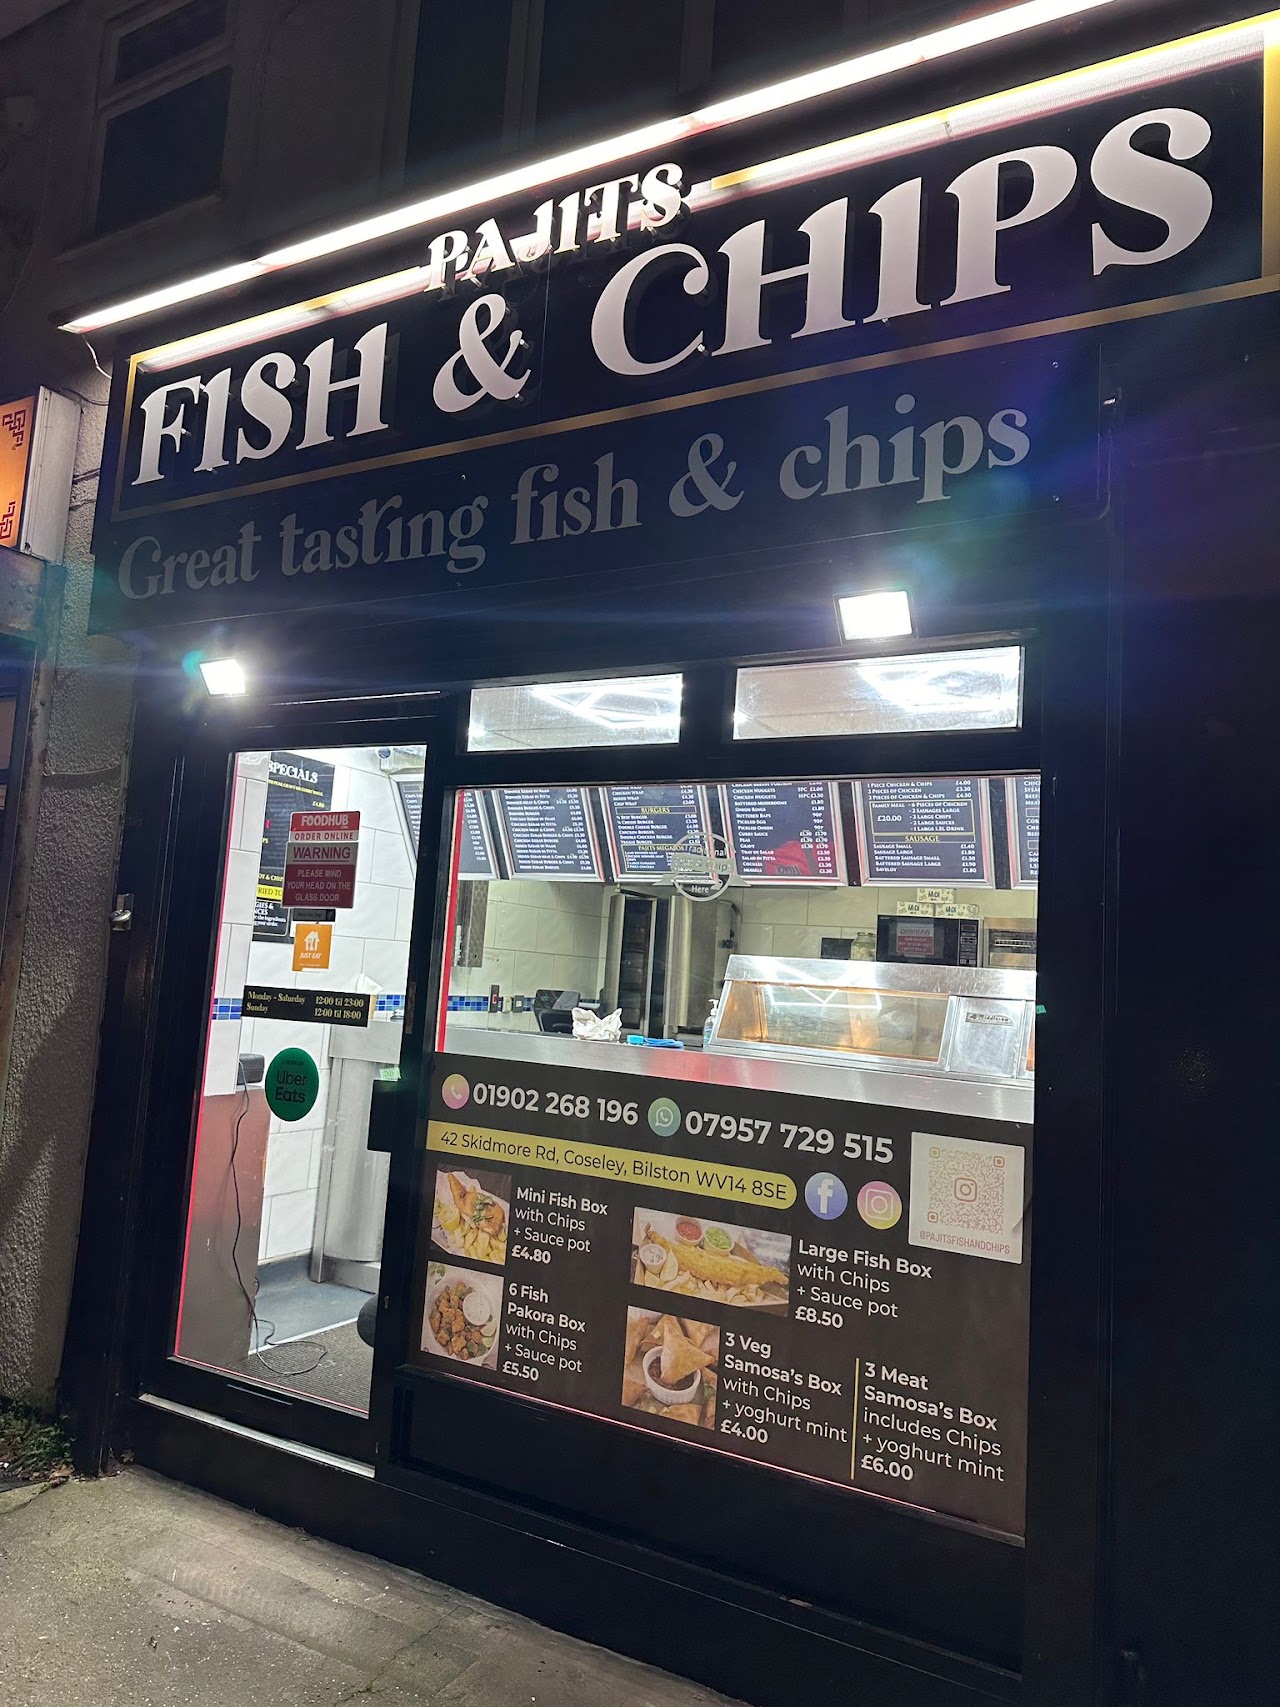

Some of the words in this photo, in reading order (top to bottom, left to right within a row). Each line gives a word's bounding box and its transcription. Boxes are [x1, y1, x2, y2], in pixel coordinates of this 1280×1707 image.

[424, 162, 686, 293] PAJITS
[131, 322, 389, 486] FISH
[433, 294, 531, 413] &
[591, 108, 1213, 376] CHIPS
[118, 521, 261, 600] Great
[279, 494, 488, 574] tasting
[510, 452, 642, 545] fish
[669, 432, 744, 518] &
[779, 393, 1030, 505] chips
[301, 814, 348, 827] FOODHUB
[294, 832, 321, 841] ORDER
[324, 831, 354, 841] ONLINE
[293, 846, 351, 860] WARNING
[287, 881, 305, 890] YOUR
[306, 881, 325, 890] HEAD
[326, 881, 337, 890] ON
[338, 881, 352, 890] THE
[297, 869, 323, 878] PLEASE
[325, 869, 342, 878] MIND
[295, 893, 318, 901] GLASS
[320, 893, 340, 901] DOOR
[691, 885, 709, 893] Here
[246, 1002, 269, 1013] Sunday
[314, 1007, 333, 1017] 12:00
[343, 1009, 362, 1020] 18:00
[247, 991, 273, 1002] Monday
[277, 992, 306, 1005] Saturday
[315, 995, 334, 1006] 12:00
[335, 996, 343, 1006] til
[343, 997, 365, 1008] 23:00
[276, 1069, 308, 1086] Uber
[275, 1087, 306, 1104] Eats
[473, 1082, 539, 1112] 01902
[545, 1091, 590, 1119] 268
[597, 1098, 639, 1126] 196
[685, 1110, 772, 1145] 07957
[779, 1122, 835, 1155] 729
[843, 1132, 894, 1164] 515
[440, 1131, 458, 1146] 42
[461, 1134, 531, 1158] Skidmore
[535, 1144, 559, 1165] Rd,
[563, 1150, 628, 1177] Coseley,
[632, 1160, 691, 1184] Bilston
[696, 1170, 747, 1194] WV14
[752, 1181, 787, 1201] 8SE
[516, 1186, 545, 1204] Mini
[549, 1191, 577, 1210] Fish
[581, 1198, 608, 1216] Box
[515, 1206, 544, 1224] with
[547, 1212, 586, 1232] Chips
[524, 1227, 564, 1248] Sauce
[567, 1235, 591, 1253] pot
[919, 1230, 1011, 1255] @PAJITSFISHANDCHIPS
[511, 1244, 551, 1265] £4.80
[798, 1239, 849, 1265] Large
[853, 1249, 890, 1272] Fish
[895, 1258, 933, 1279] Box
[797, 1262, 835, 1283] with
[839, 1269, 891, 1294] Chips
[508, 1283, 518, 1296] 6
[520, 1285, 549, 1304] Fish
[797, 1286, 806, 1297] +
[810, 1286, 864, 1311] Sauce
[867, 1298, 899, 1319] pot
[507, 1302, 555, 1325] Pakora
[558, 1315, 587, 1333] Box
[795, 1306, 845, 1329] £8.50
[506, 1323, 535, 1342] with
[538, 1329, 577, 1351] Chips
[724, 1332, 736, 1347] 3
[739, 1335, 772, 1359] Veg
[502, 1361, 540, 1382] £5.50
[515, 1344, 555, 1366] Sauce
[558, 1355, 583, 1373] pot
[723, 1354, 804, 1386] Samosa's
[808, 1375, 843, 1396] Box
[864, 1362, 876, 1378] 3
[881, 1365, 929, 1391] Meat
[723, 1377, 759, 1398] with
[763, 1385, 812, 1411] Chips
[722, 1400, 731, 1410] +
[735, 1400, 802, 1431] yoghurt
[806, 1420, 848, 1443] mint
[864, 1386, 954, 1420] Samosa's
[959, 1409, 998, 1431] Box
[720, 1419, 769, 1444] £4.00
[863, 1408, 941, 1441] includes
[946, 1430, 1002, 1456] Chips
[861, 1454, 914, 1481] £6.00
[863, 1433, 873, 1444] +
[876, 1434, 953, 1469] yoghurt
[958, 1458, 1005, 1482] mint
